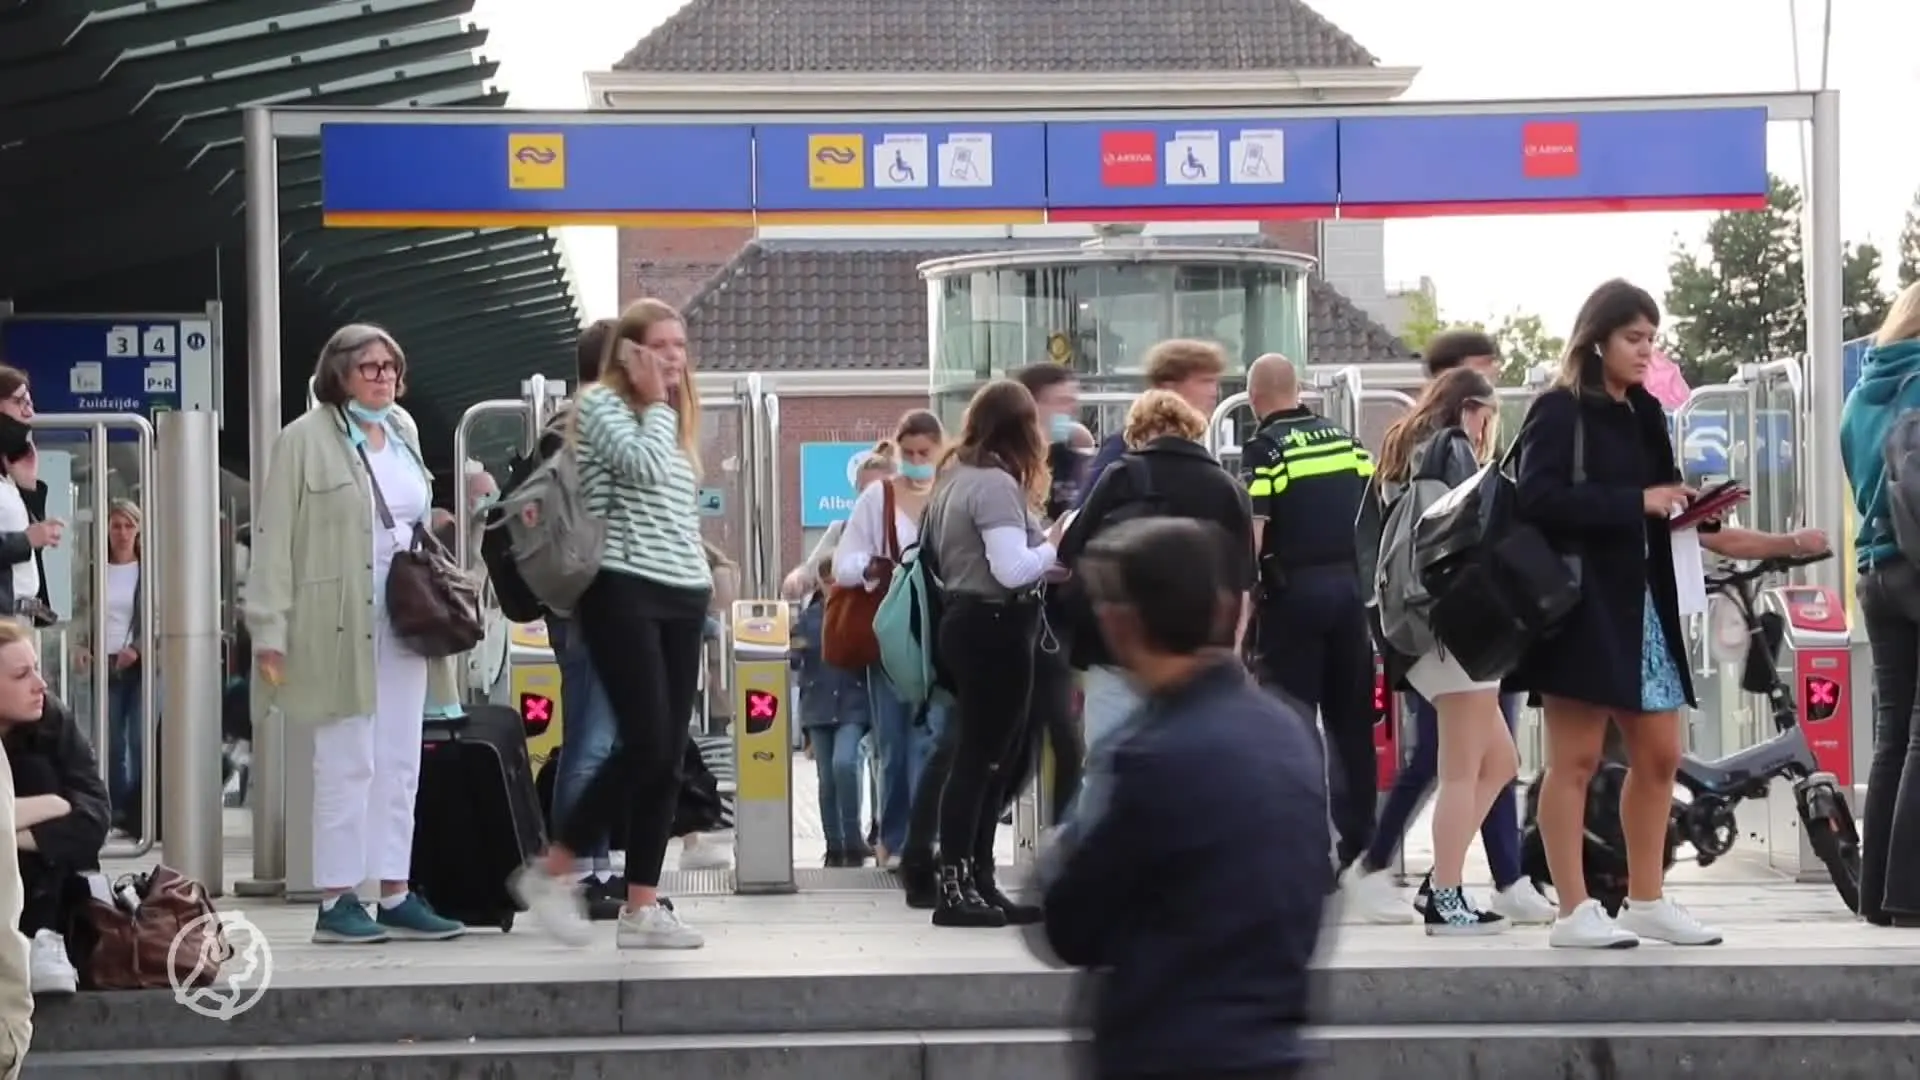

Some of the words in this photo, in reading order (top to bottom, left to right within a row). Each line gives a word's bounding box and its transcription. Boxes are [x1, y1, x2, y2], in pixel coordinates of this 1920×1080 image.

[116, 336, 128, 354] 3
[153, 336, 166, 353] 4
[78, 396, 140, 410] Zuidzijde
[818, 496, 856, 511] Albe
